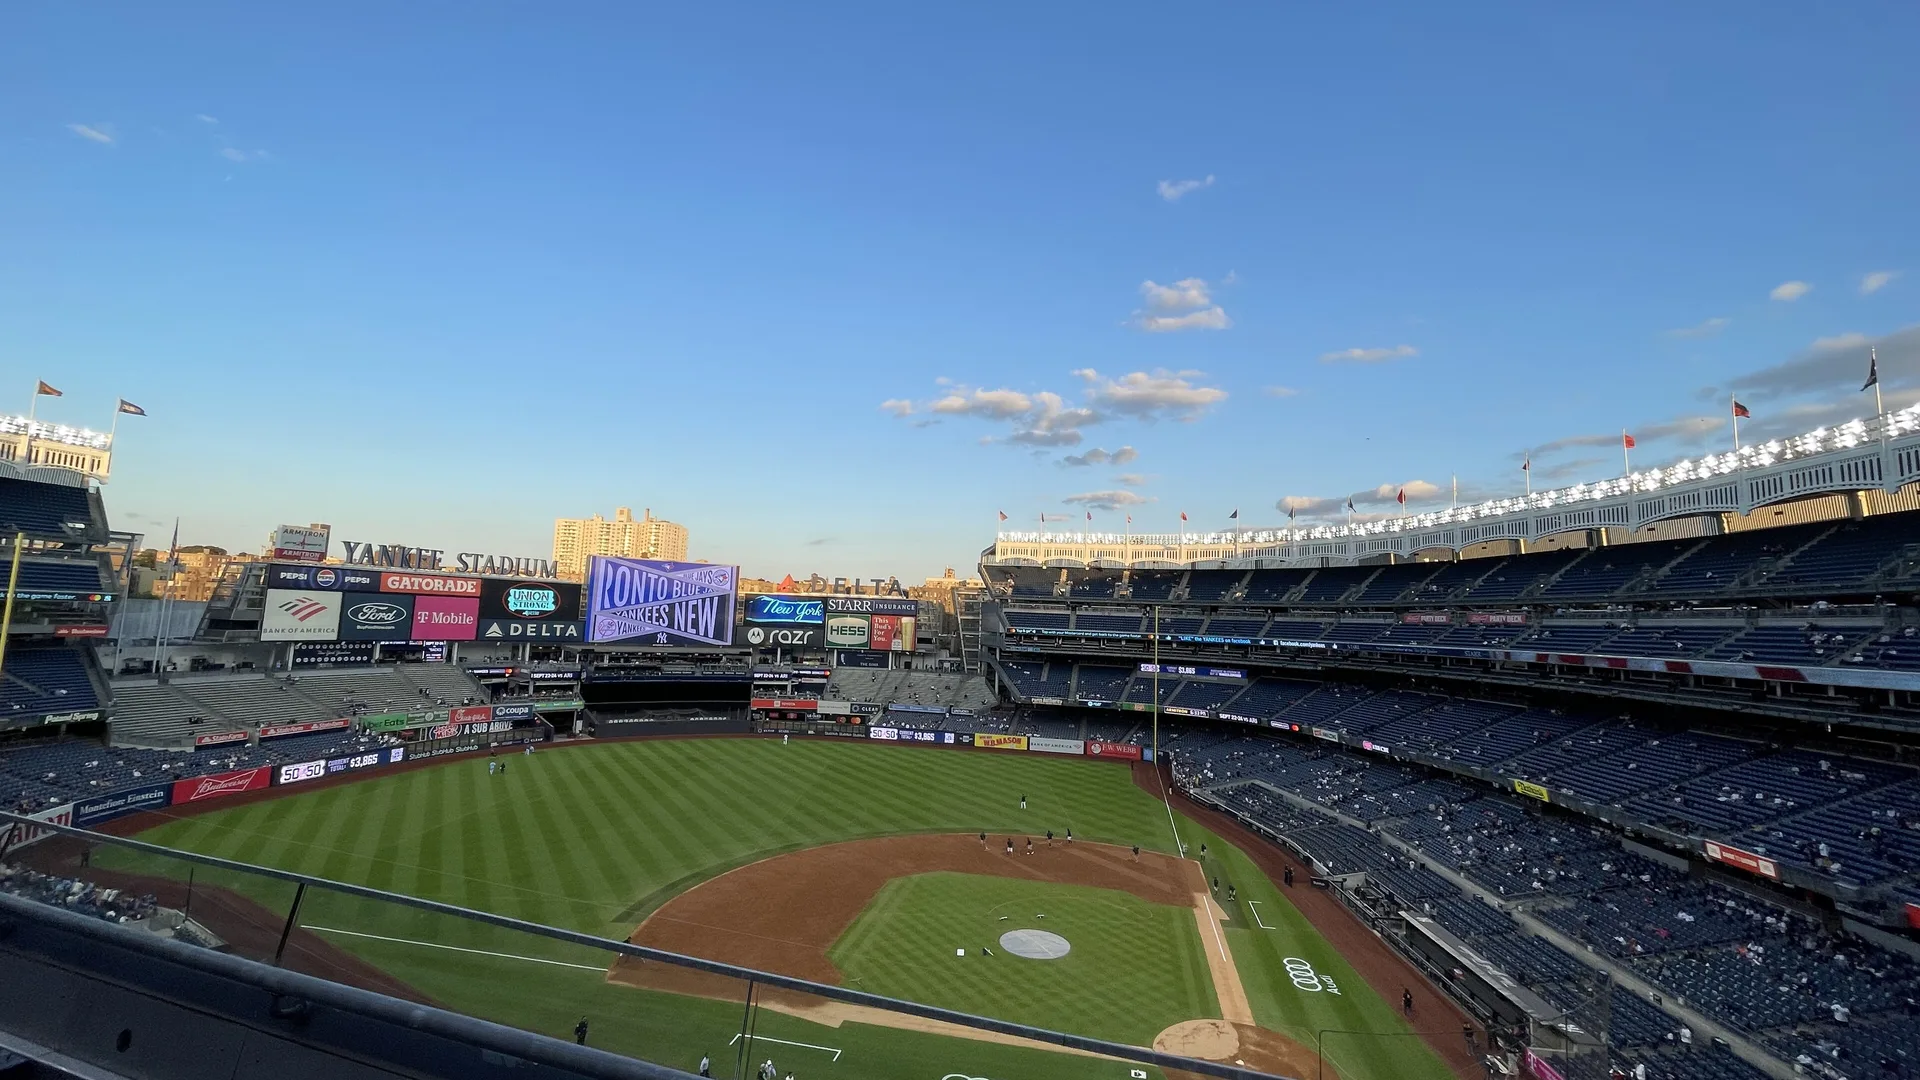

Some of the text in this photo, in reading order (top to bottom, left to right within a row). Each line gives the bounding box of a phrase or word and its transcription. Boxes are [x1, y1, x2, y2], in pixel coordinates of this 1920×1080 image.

[283, 528, 325, 538] ARMITRON
[282, 550, 320, 558] ARMITRON
[341, 541, 559, 578] YANKEE STADIUM
[280, 572, 308, 580] PEPSI
[344, 576, 370, 584] PEPSI
[695, 570, 712, 584] JAYS
[387, 576, 476, 592] GATORADE
[672, 580, 700, 598] BLUE
[811, 577, 902, 596] DELTA
[513, 590, 550, 601] UNION
[358, 605, 397, 620] Ford
[757, 596, 824, 622] New York
[828, 600, 872, 612] STARR
[431, 612, 474, 624] Mobile
[616, 596, 718, 638] YANKEES NEW
[510, 624, 578, 636] DELTA
[617, 620, 646, 635] YANKEES
[830, 626, 866, 636] HESS
[770, 630, 814, 644] razr
[44, 712, 98, 724] Poland Spring
[464, 724, 470, 734] A
[472, 723, 488, 733] SUB
[489, 721, 513, 731] ABOVE
[409, 752, 430, 760] StubHub
[455, 745, 478, 753] StubHub
[328, 758, 350, 767] CURRENT
[350, 753, 378, 768] $3,865
[200, 780, 248, 793] Budweiser
[80, 790, 164, 816] Montefiore Einstein
[1319, 974, 1341, 995] Audi
